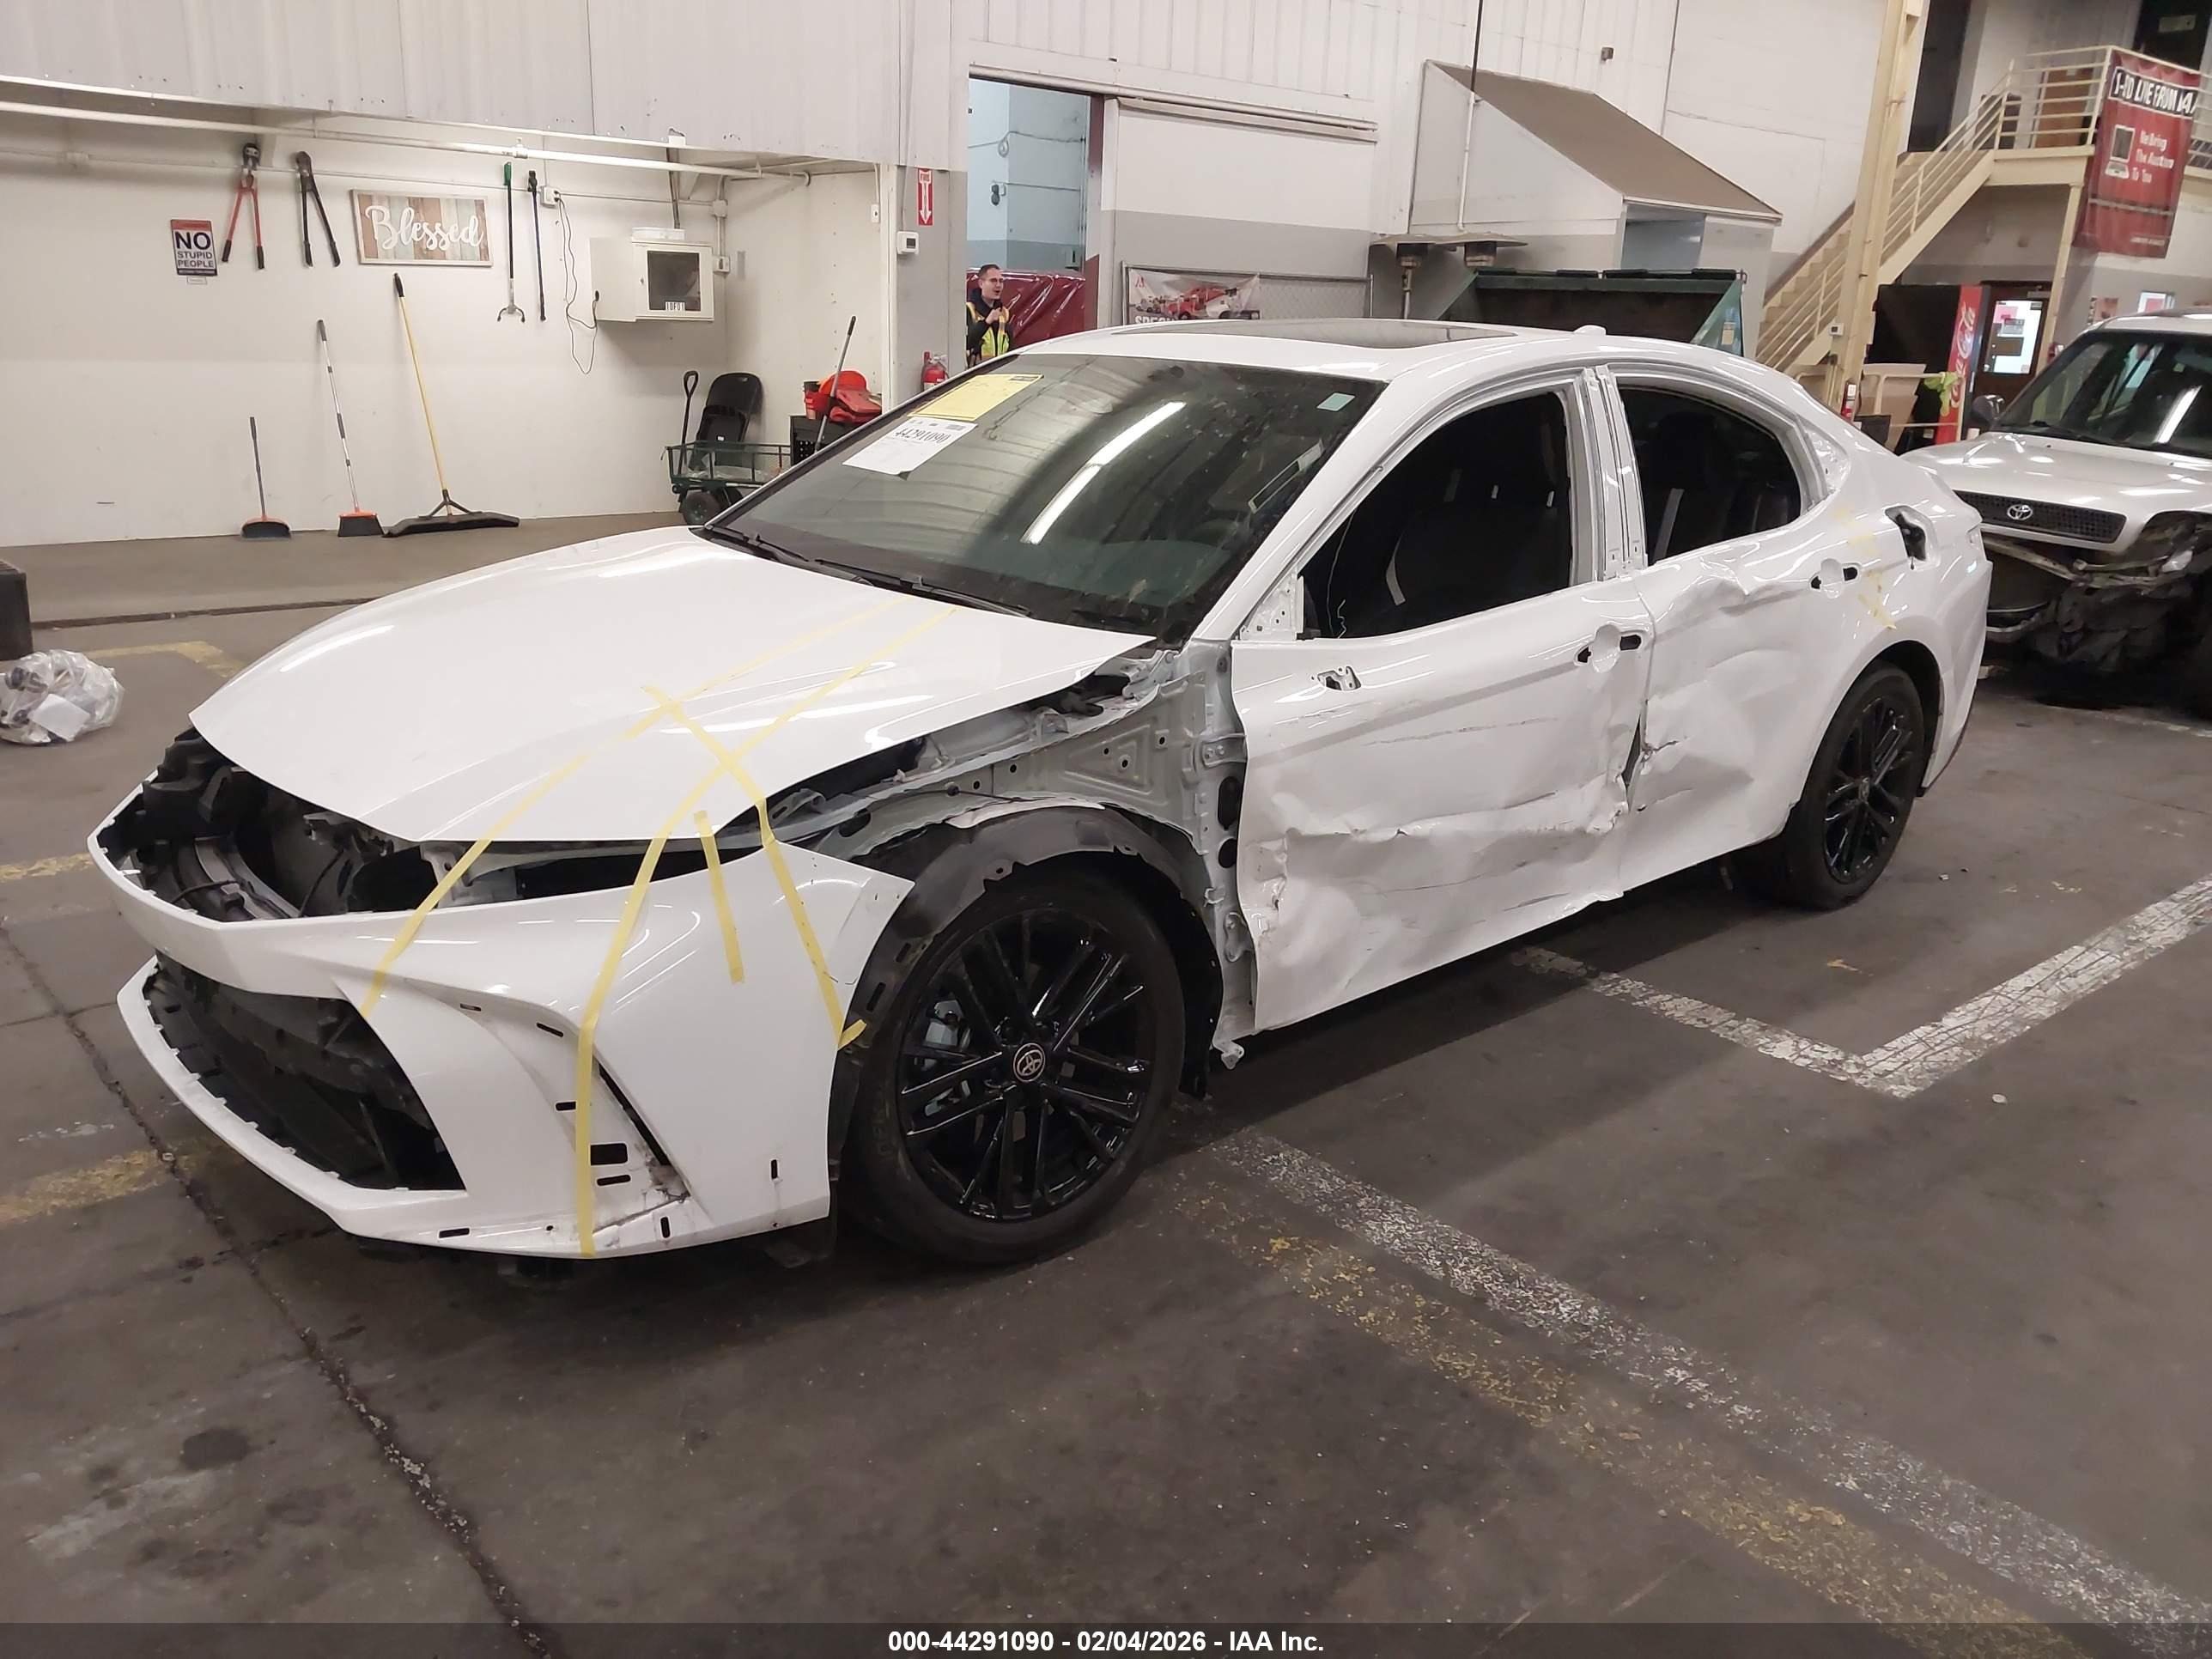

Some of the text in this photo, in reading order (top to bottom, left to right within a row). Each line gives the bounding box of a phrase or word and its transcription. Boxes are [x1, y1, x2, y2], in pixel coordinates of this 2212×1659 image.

[365, 205, 484, 251] Blessed
[174, 231, 211, 250] NO
[177, 251, 213, 259] STUPID
[177, 259, 215, 268] PEOPLE
